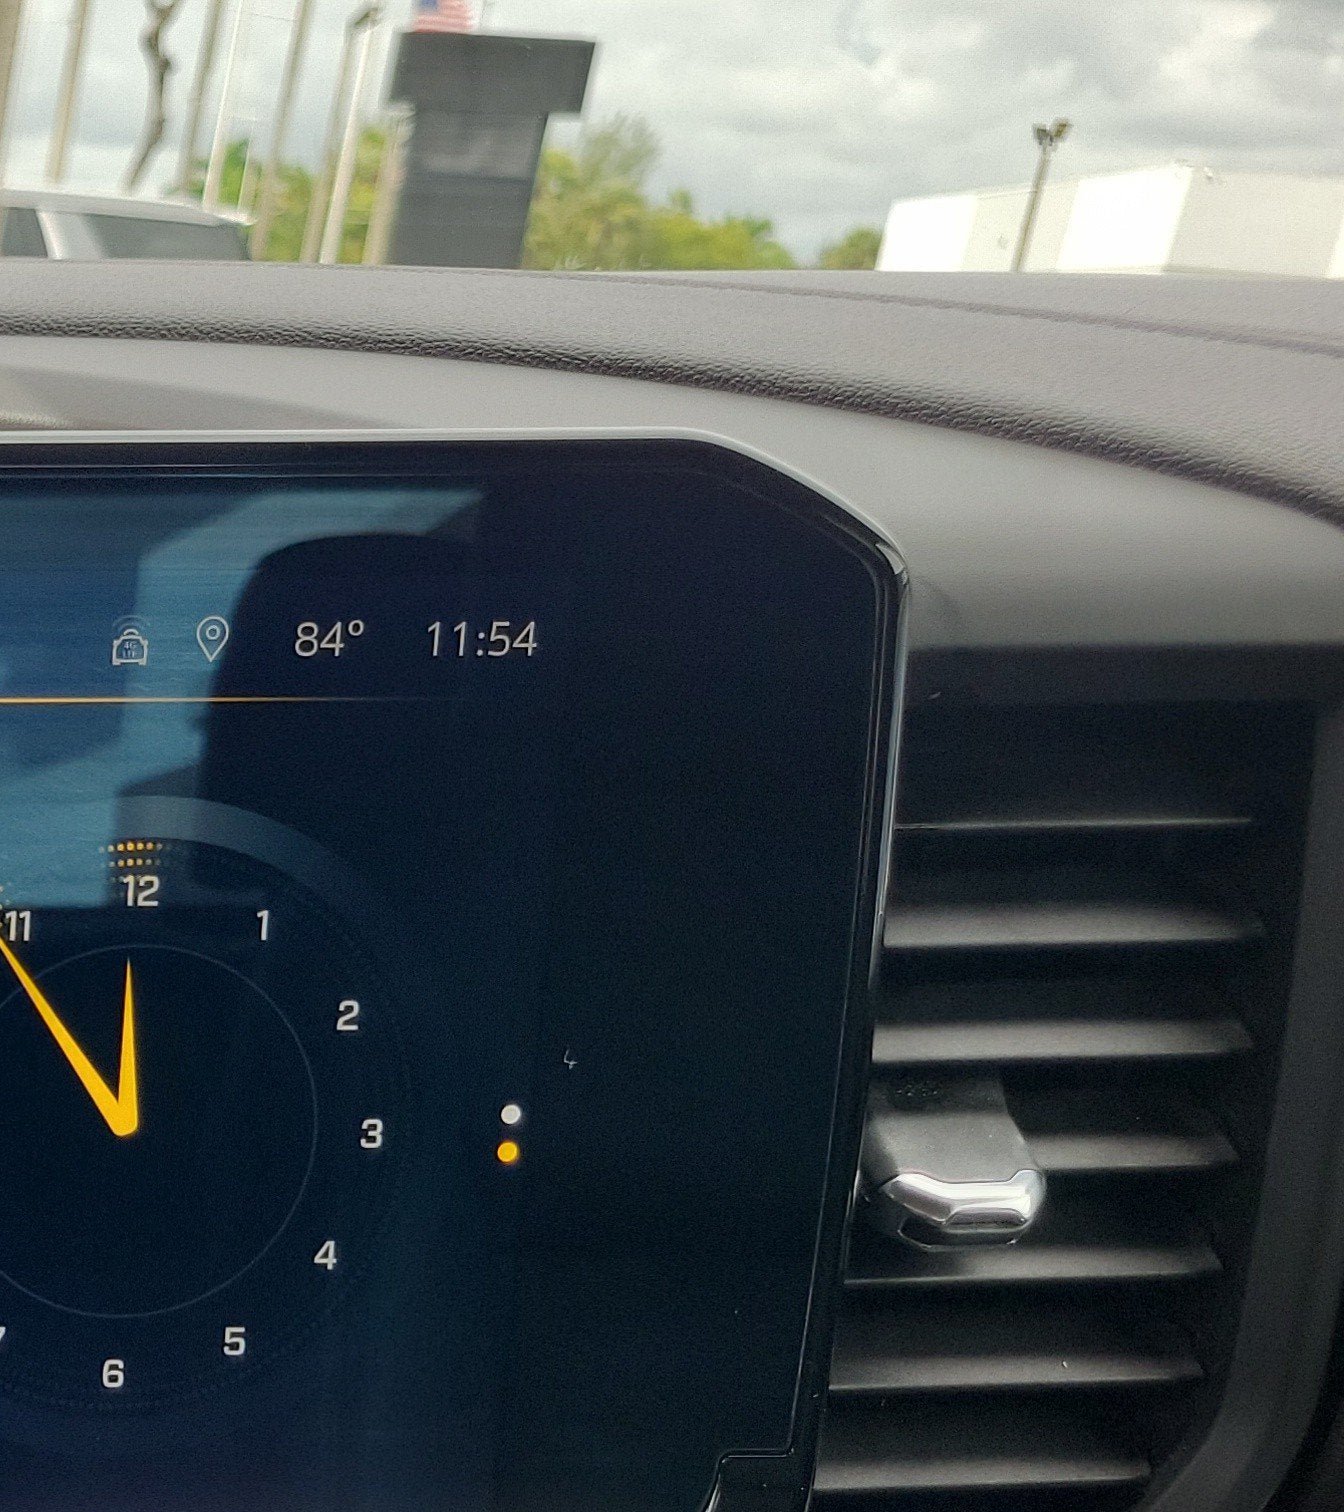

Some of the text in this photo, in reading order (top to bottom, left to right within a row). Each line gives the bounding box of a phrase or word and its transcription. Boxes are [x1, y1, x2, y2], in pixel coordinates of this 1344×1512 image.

[427, 620, 538, 657] 11:54
[120, 874, 160, 907] 12
[5, 910, 31, 942] 11
[256, 909, 270, 941] 1
[336, 999, 360, 1031] 2
[360, 1118, 384, 1149] 3
[313, 1240, 338, 1271] 4
[223, 1326, 246, 1356] 5
[102, 1359, 125, 1389] 6
